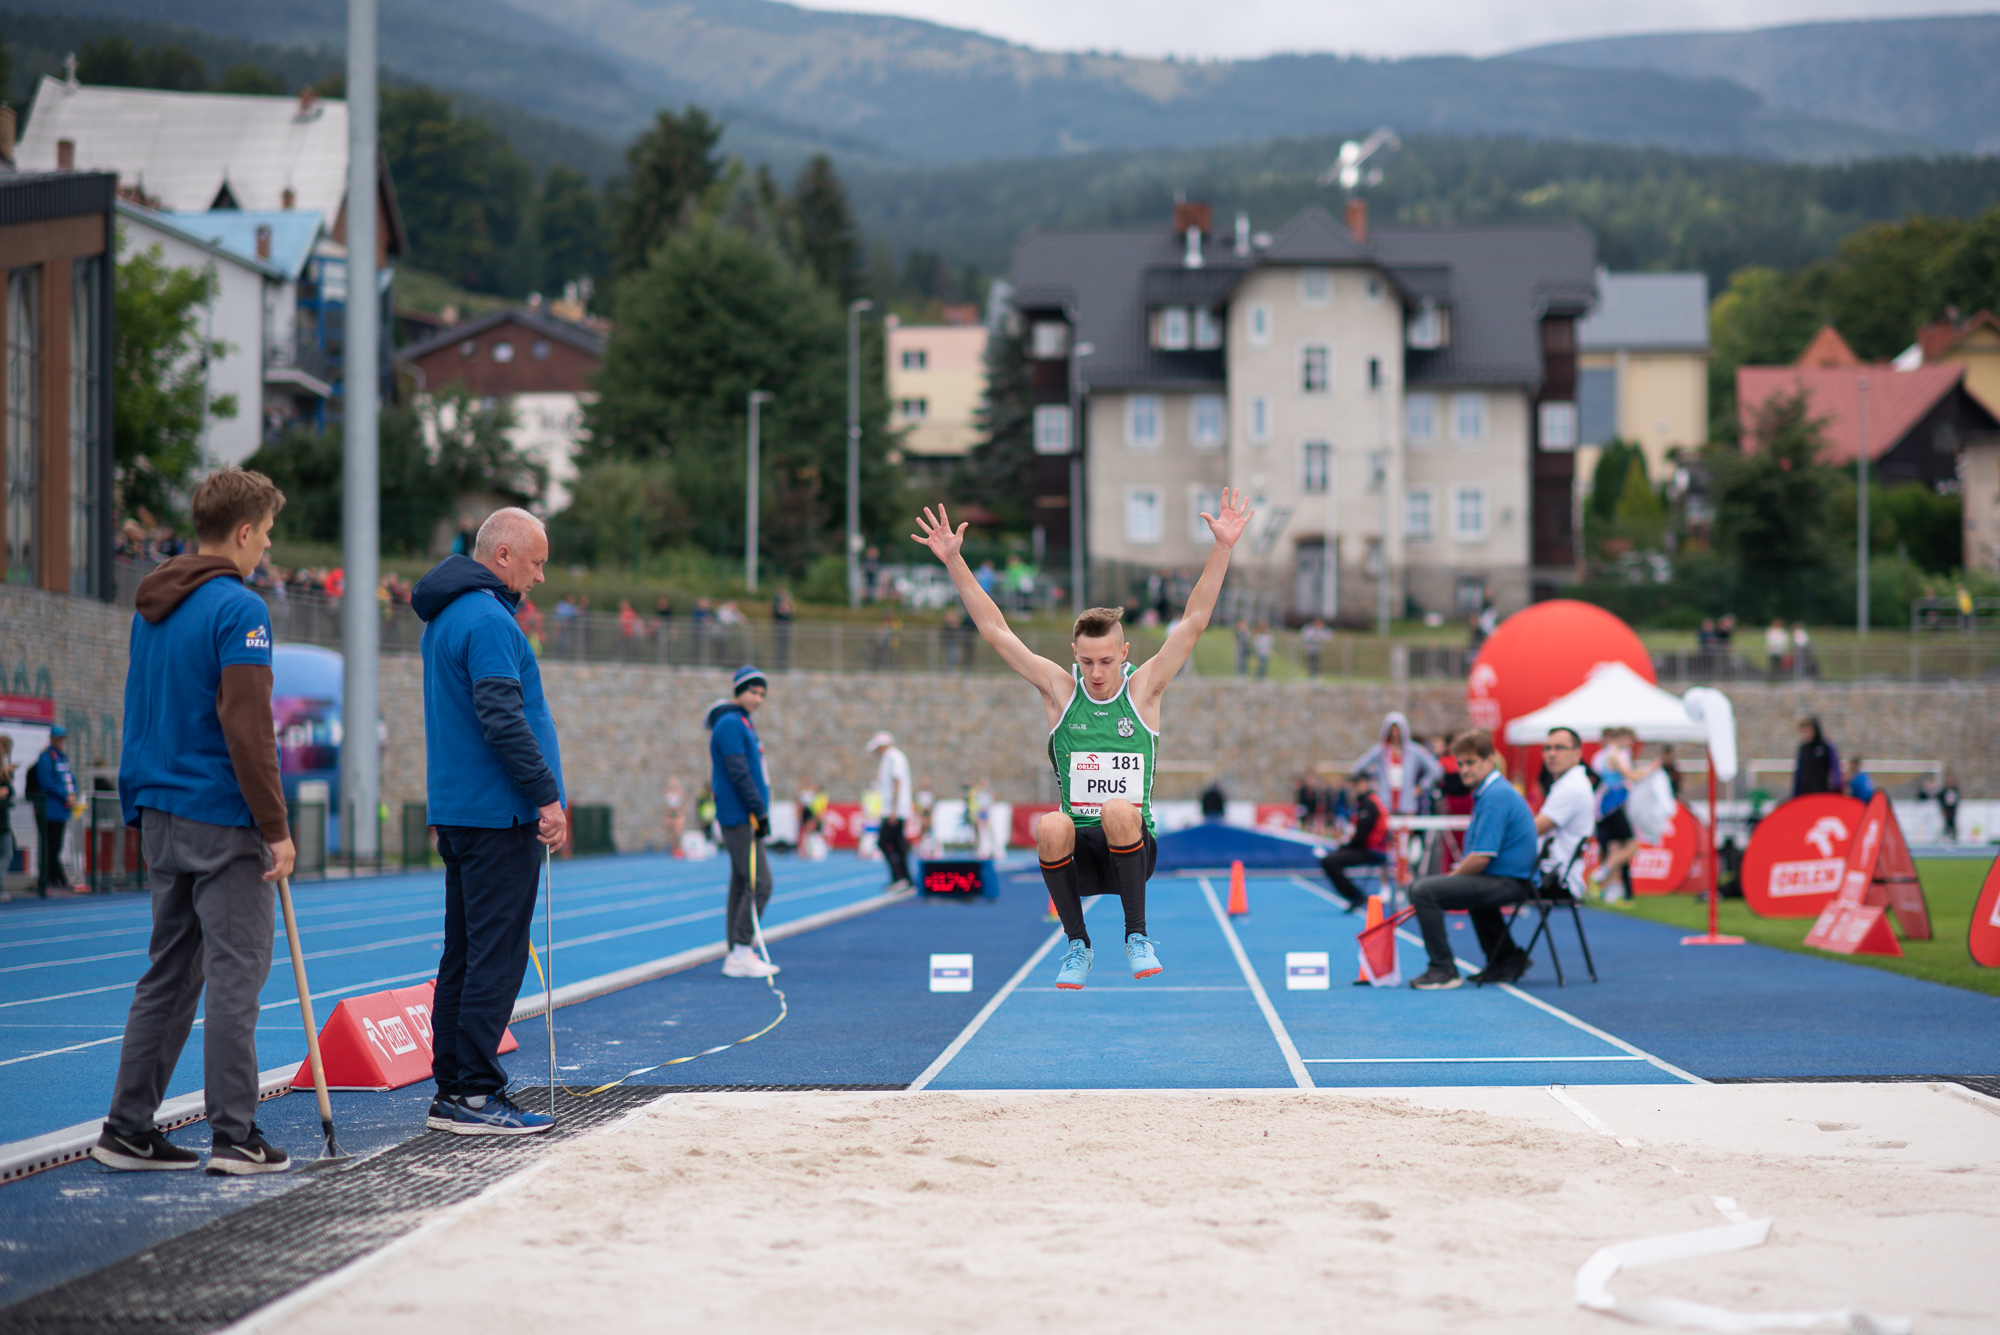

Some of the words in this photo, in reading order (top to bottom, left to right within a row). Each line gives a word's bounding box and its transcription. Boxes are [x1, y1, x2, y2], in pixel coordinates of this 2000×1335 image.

[1112, 756, 1140, 770] 181
[1087, 777, 1127, 793] PRUŚ
[383, 1021, 414, 1048] ORLEN
